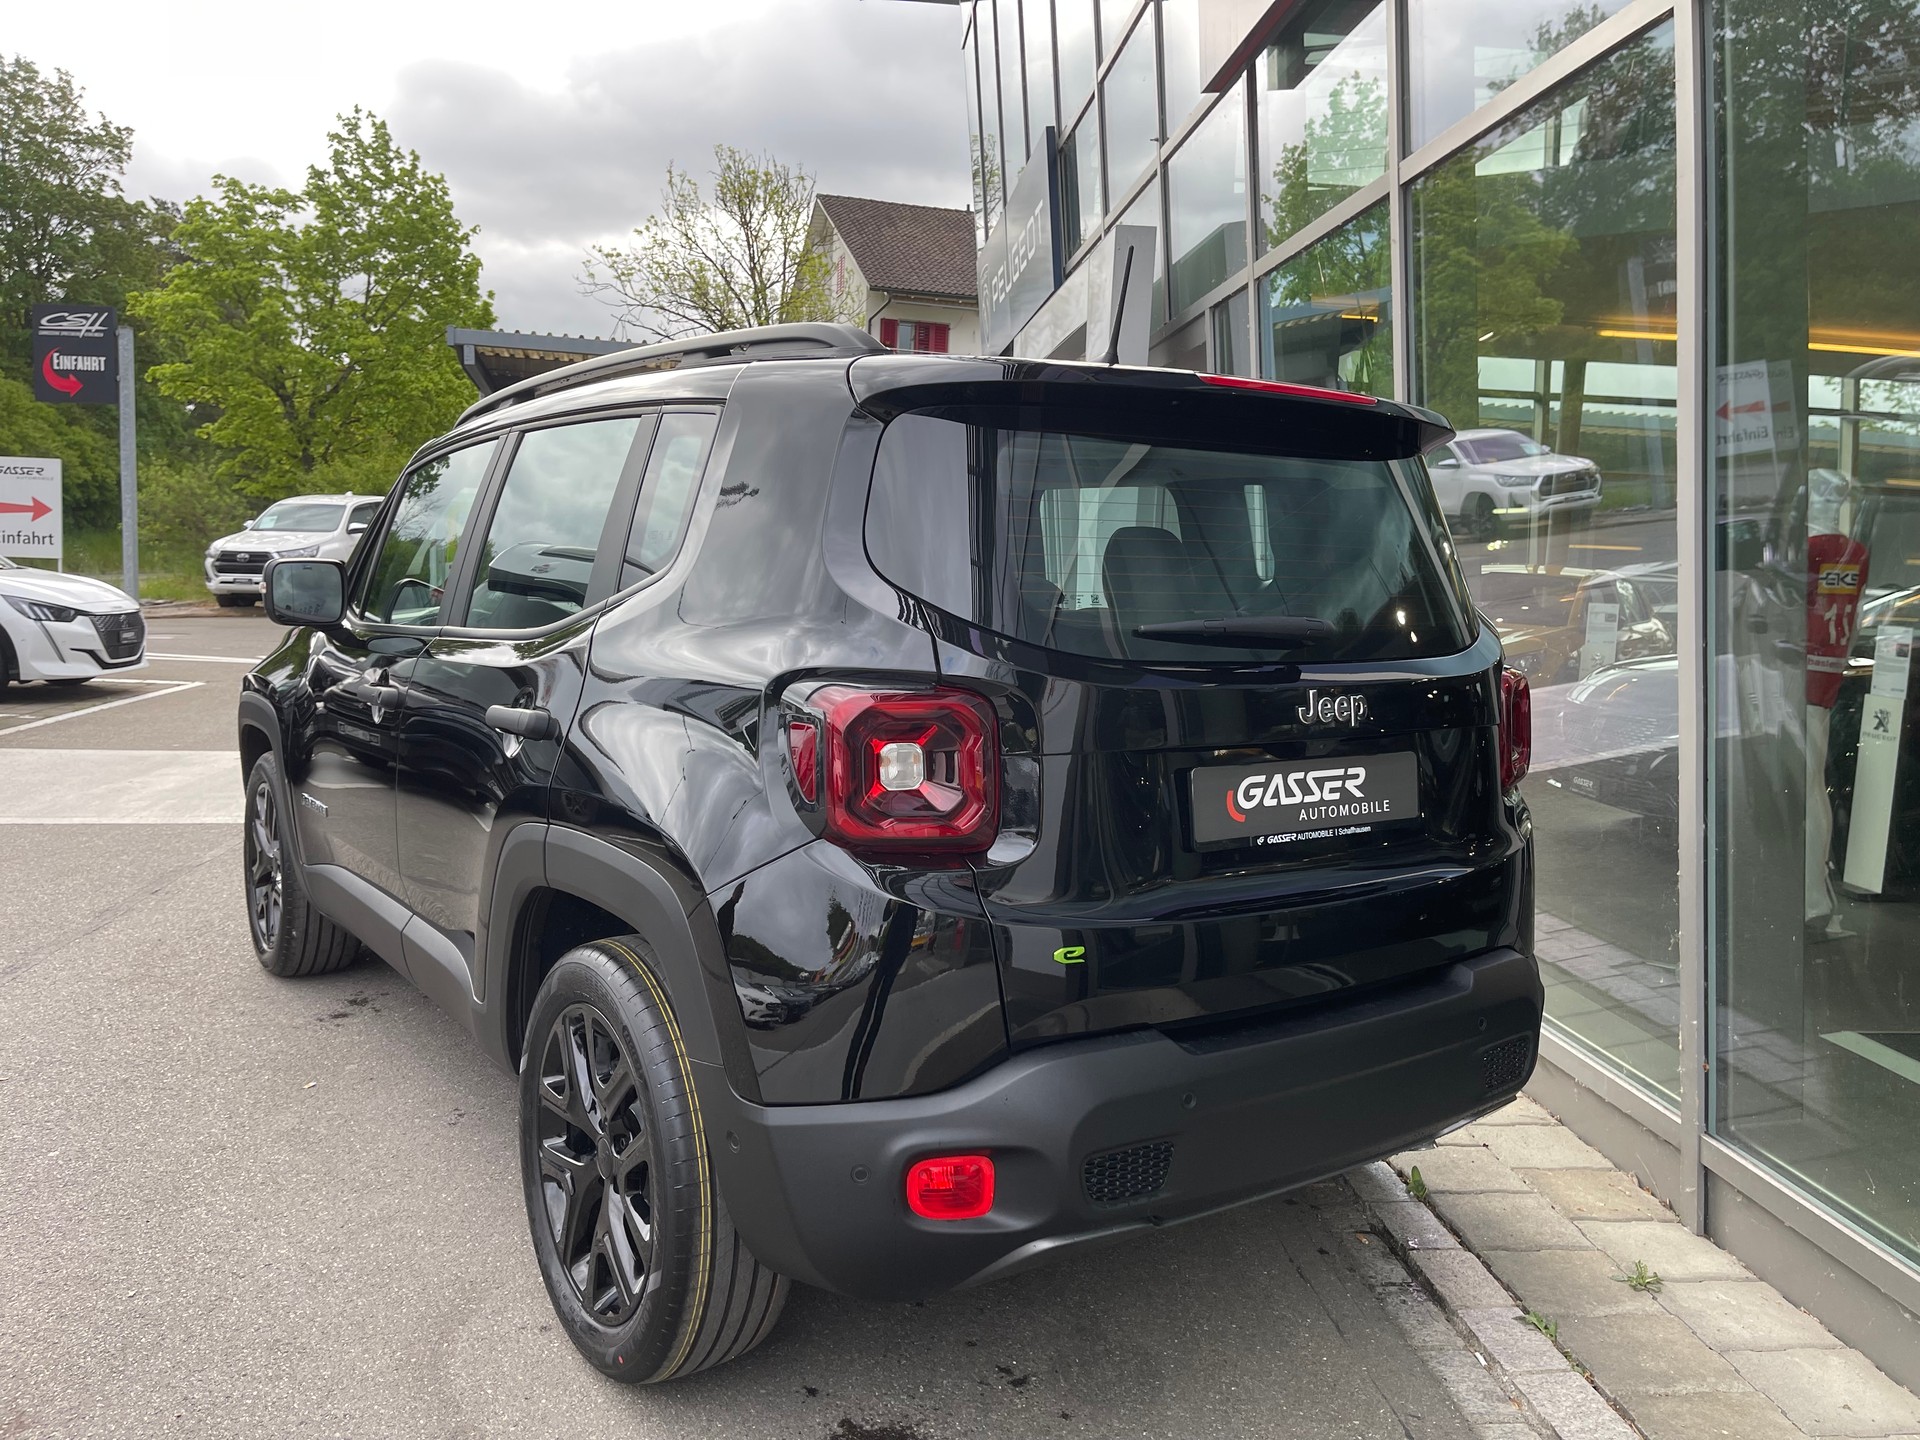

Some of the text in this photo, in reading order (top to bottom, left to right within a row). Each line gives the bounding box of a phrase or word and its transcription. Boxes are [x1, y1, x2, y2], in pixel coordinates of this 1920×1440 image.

[991, 199, 1043, 312] PEUGEOT
[0, 530, 55, 545] infahrt
[1298, 689, 1368, 727] Jeep
[1236, 766, 1366, 810] GASSER
[1298, 800, 1391, 822] AUTOMOBILE
[1266, 832, 1297, 845] GASSER
[1297, 828, 1334, 842] AUTOMOBILE
[1338, 825, 1372, 836] Schaffhausen
